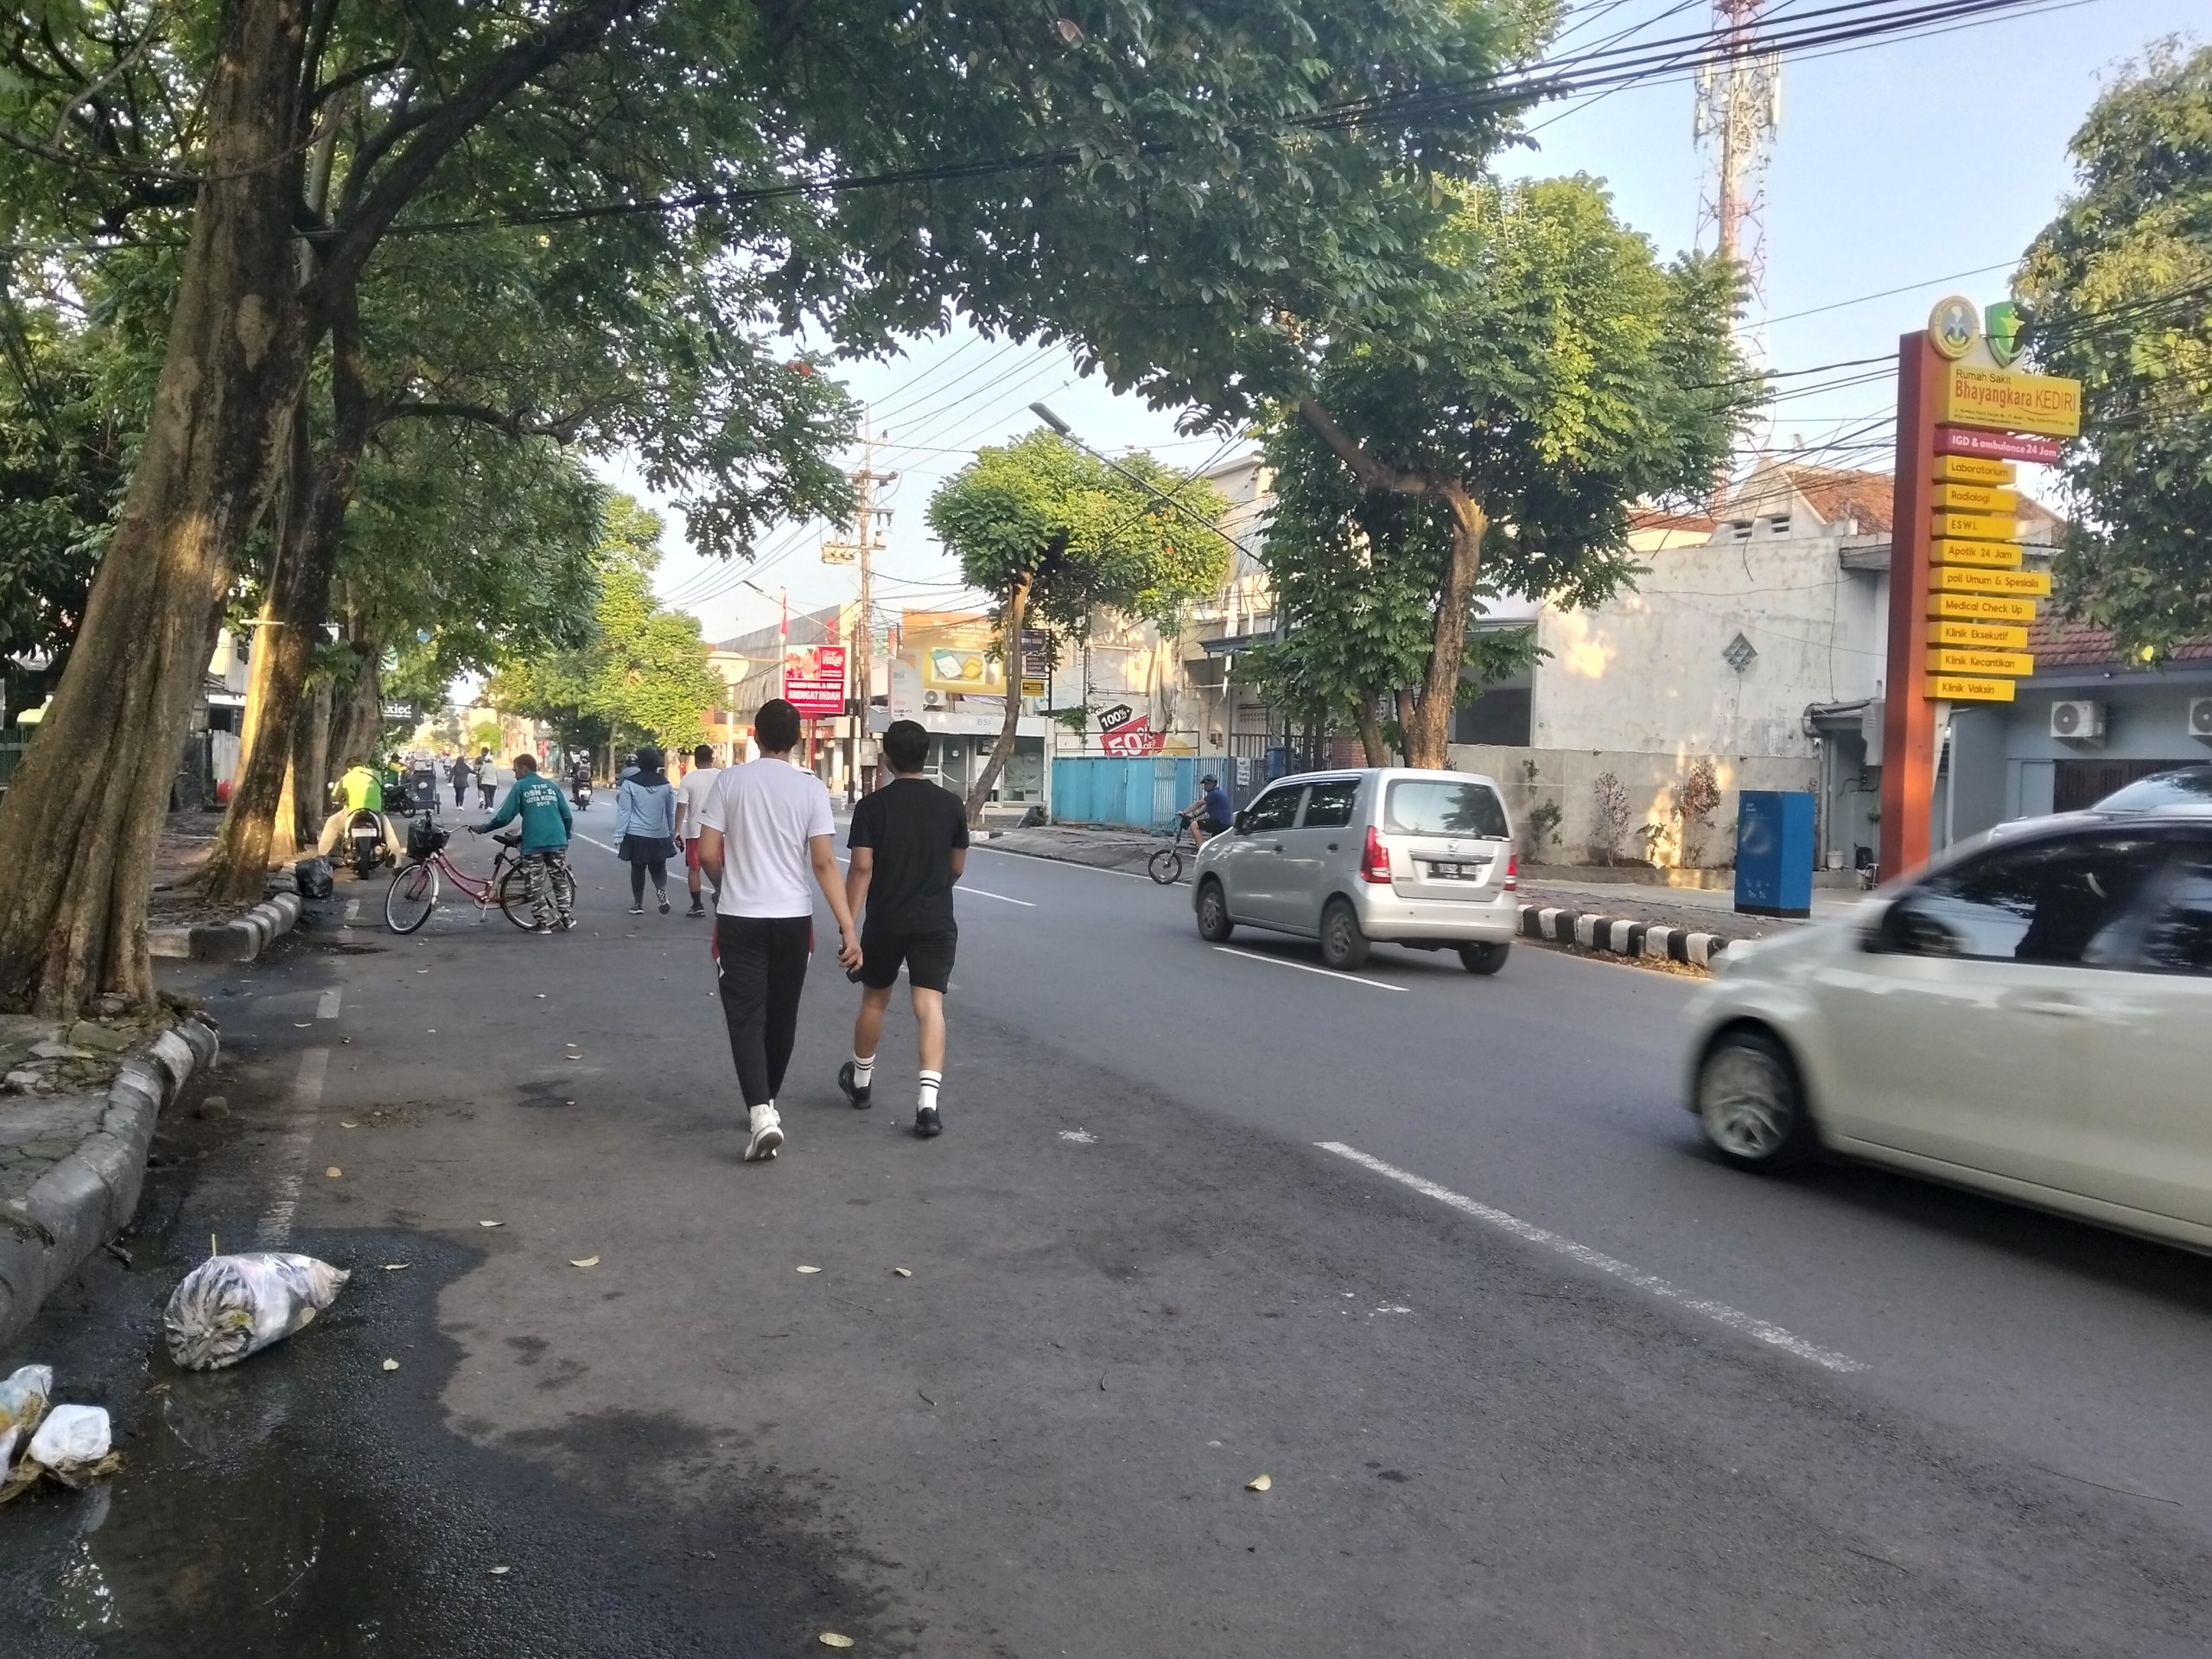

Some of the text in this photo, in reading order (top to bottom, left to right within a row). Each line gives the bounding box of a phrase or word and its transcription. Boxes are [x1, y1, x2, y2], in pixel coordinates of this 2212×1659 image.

[1955, 369, 2012, 385] Rumah Sakit
[1955, 379, 2075, 412] Bhayangkara KEDIRI
[1952, 435, 2057, 458] IGD & ambulance 24 Jam
[1951, 462, 2009, 478] Laboratorium
[1951, 489, 1991, 505] Radiologi
[1948, 545, 2012, 560] Apotik 24 Jam
[1948, 574, 2039, 589] poli Umum & Spesialis
[1945, 601, 2023, 616] Medical Check Up
[1945, 627, 2009, 641] Klinik Eksekutif
[1945, 654, 2015, 669] Klinik Kecantikan
[788, 690, 842, 701] SRENGAT INDAH
[1942, 682, 1995, 695] Klinik Vaksin
